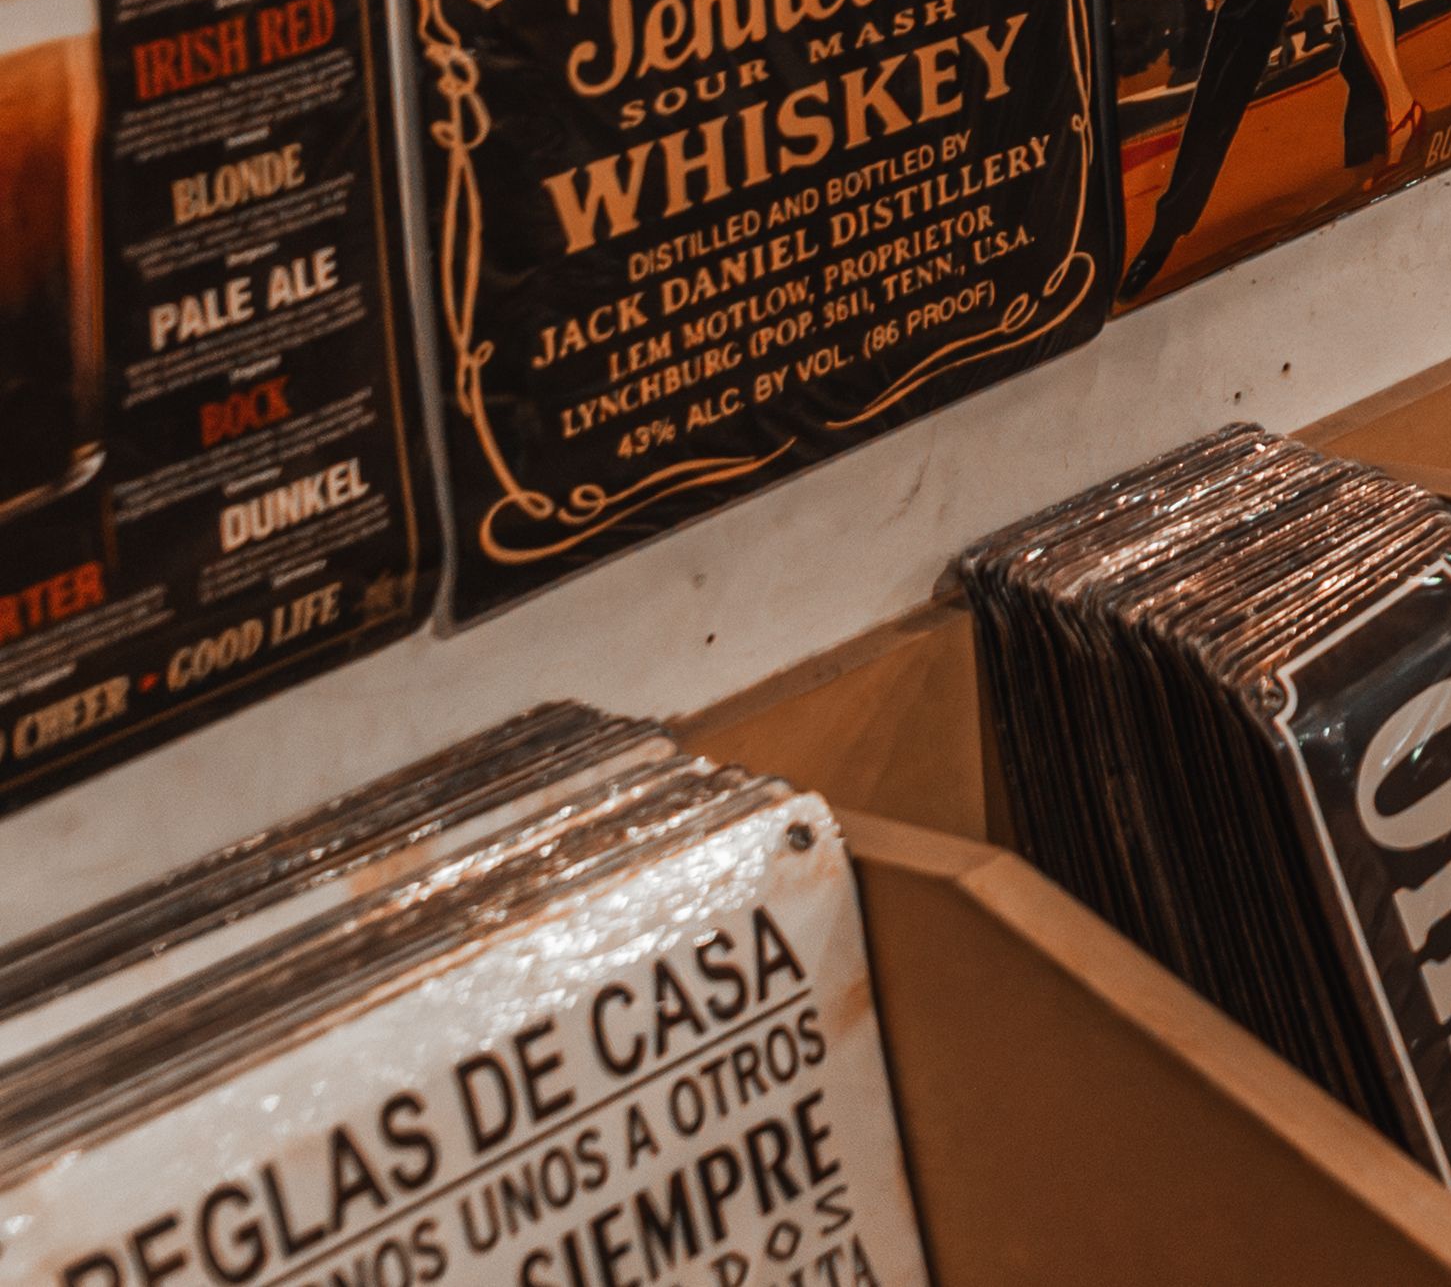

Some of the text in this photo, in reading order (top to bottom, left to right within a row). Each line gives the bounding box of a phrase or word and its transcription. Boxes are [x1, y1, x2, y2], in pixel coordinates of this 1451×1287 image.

[133, 14, 249, 102] IRISH
[543, 13, 1029, 255] WHISKEY
[619, 58, 769, 131] SOUR
[171, 142, 306, 226] BLONDE
[531, 134, 1051, 369] JACK DANIEL DISTILLERY
[628, 129, 971, 283] DISTILLED AND BOTTLED BY
[148, 245, 339, 352] PALE ALE
[609, 205, 994, 383] LEM MOTLOW, PROPRIETOR
[219, 457, 370, 554] DUNKEL
[12, 581, 344, 760] CHEER GOOD LIFE
[455, 1021, 577, 1153] DE
[588, 904, 806, 1079] CASA
[457, 1007, 827, 1254] UNOS A OTROS
